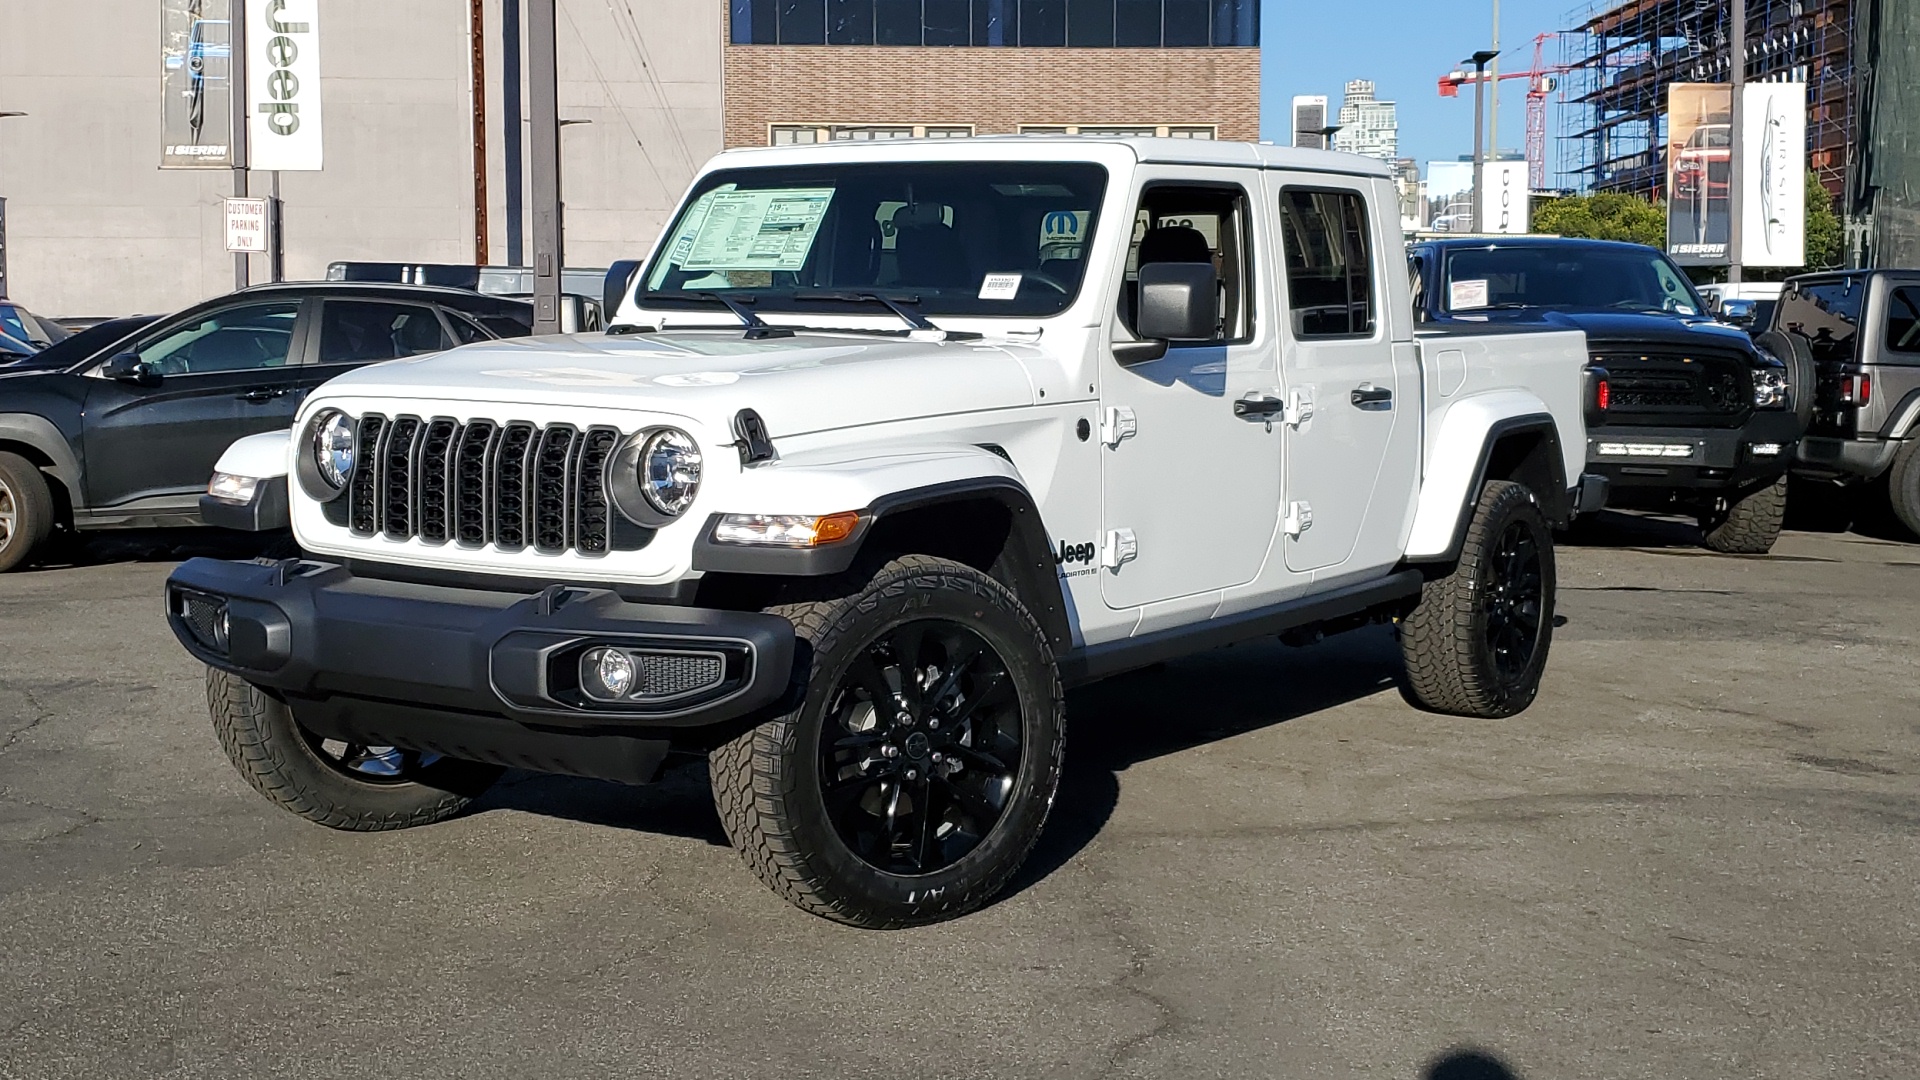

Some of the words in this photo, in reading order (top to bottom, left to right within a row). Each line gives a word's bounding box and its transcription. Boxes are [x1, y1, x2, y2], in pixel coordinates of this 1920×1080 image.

[175, 145, 227, 155] SIERRA
[228, 203, 262, 215] CUSTOMER
[231, 219, 259, 231] PARKING
[237, 236, 253, 247] ONLY
[1679, 244, 1725, 254] SIERRA
[1053, 540, 1095, 565] Jeep
